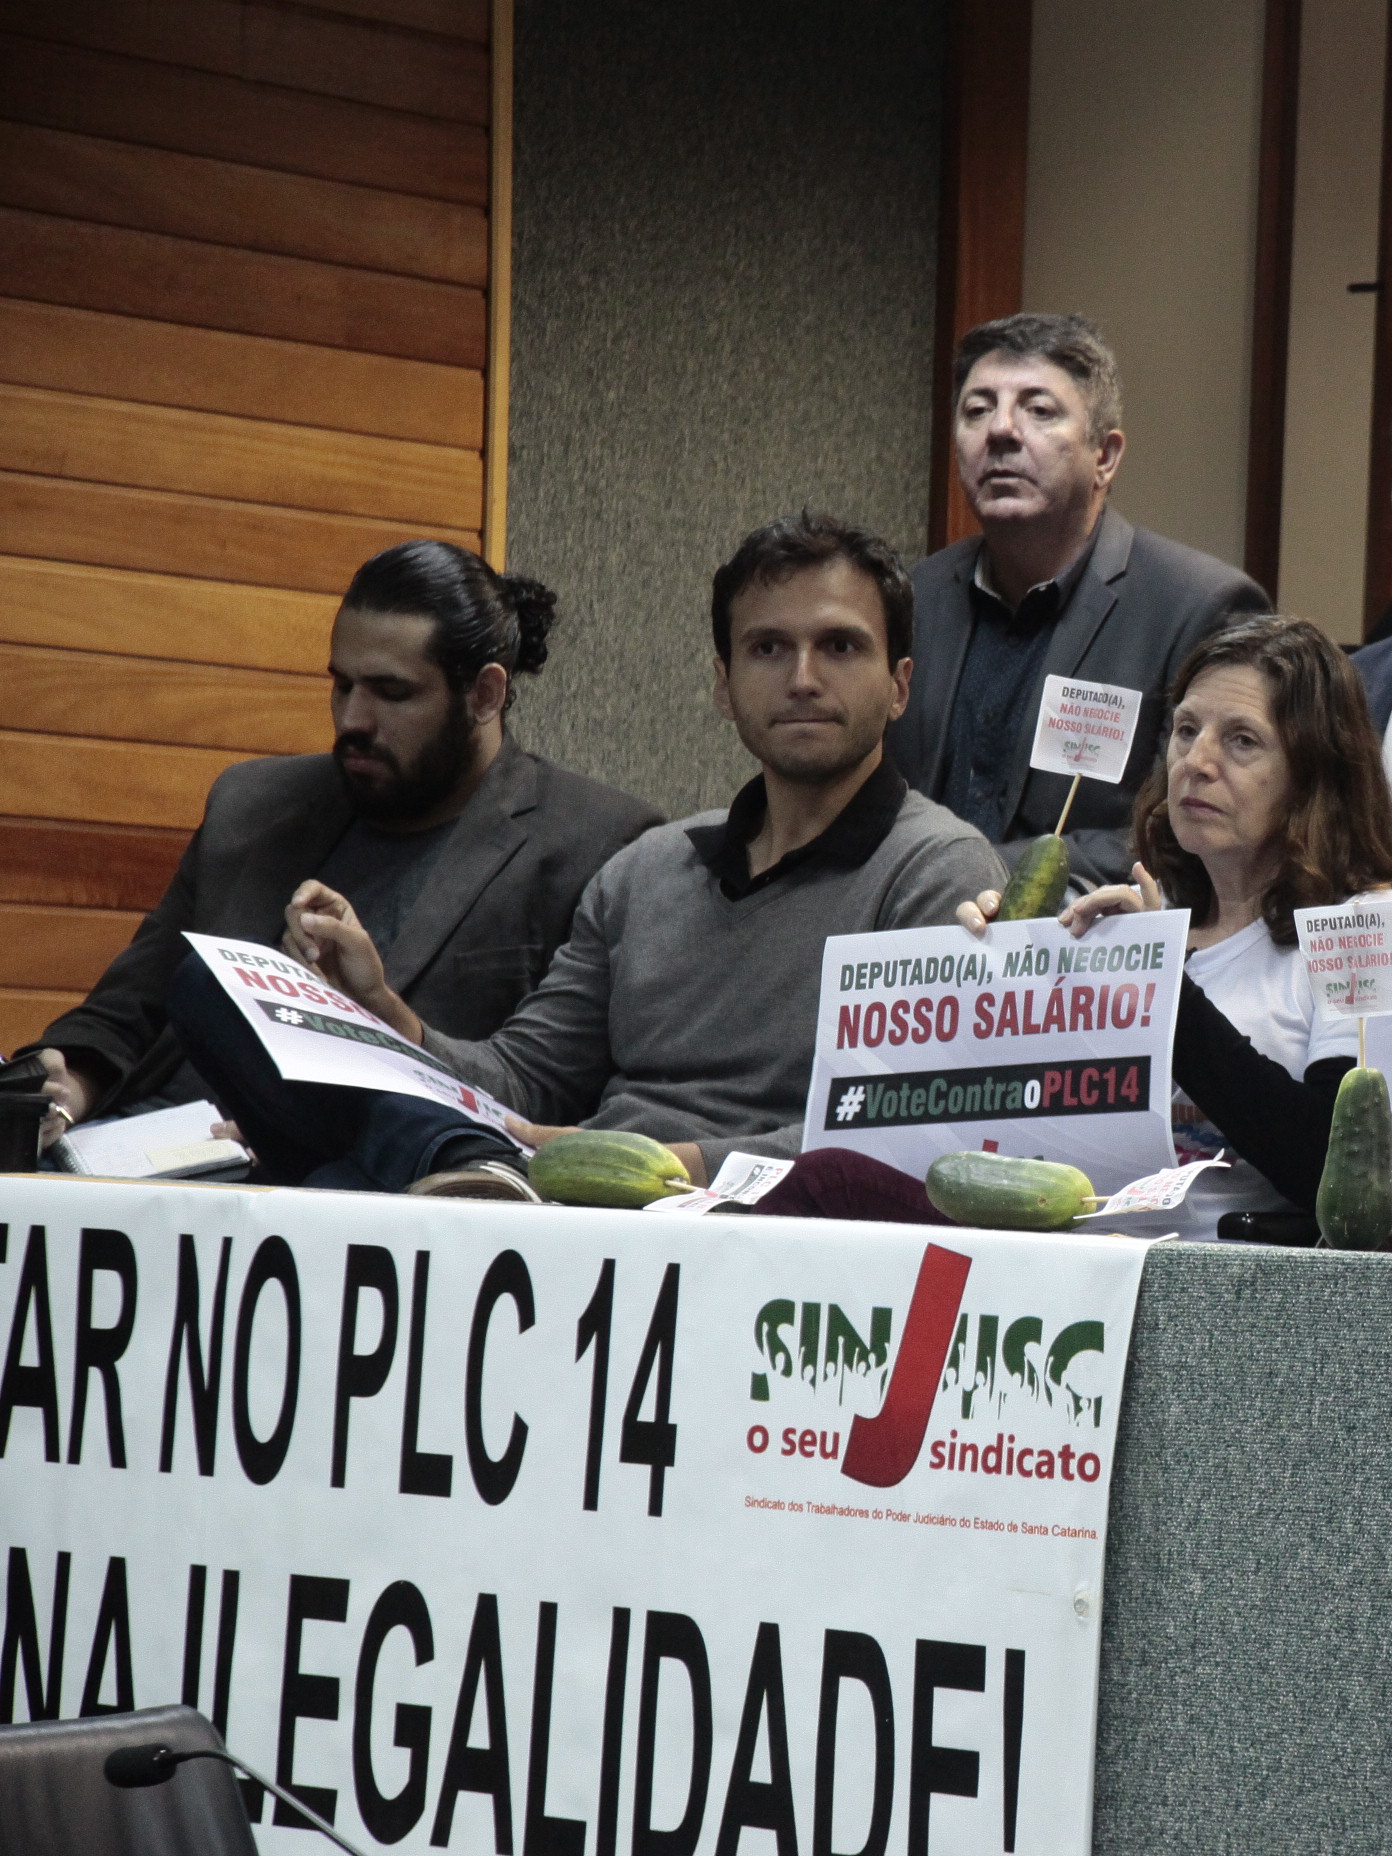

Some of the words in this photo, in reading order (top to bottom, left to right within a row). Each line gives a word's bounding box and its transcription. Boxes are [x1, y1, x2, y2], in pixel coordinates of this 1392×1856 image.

[1048, 717, 1082, 733] NOSSO
[840, 953, 993, 991] DEPUTADO(A),
[1002, 944, 1050, 978] NÃO
[1057, 942, 1165, 974] NEGOCIE
[1310, 935, 1334, 953] NÃO
[836, 995, 960, 1050] NOSSO
[972, 976, 1156, 1040] SALÁRIO!
[835, 1066, 1140, 1122] #VoteContraoPLC14
[0, 1222, 138, 1470] AR
[158, 1233, 302, 1486] NO
[330, 1244, 536, 1507] PLC
[574, 1258, 681, 1518] 14
[747, 1425, 769, 1454] o
[781, 1428, 840, 1461] seu
[929, 1430, 1102, 1483] sindicato
[745, 1495, 786, 1512] Sindicato
[788, 1500, 804, 1513] dos
[806, 1501, 870, 1519] Trabalhadores
[872, 1508, 884, 1521] do
[886, 1509, 911, 1523] Poder
[913, 1511, 957, 1527] Judiciário
[959, 1516, 971, 1528] do
[974, 1517, 1005, 1532] Estado
[1007, 1521, 1018, 1533] de
[1021, 1522, 1049, 1536] Santa
